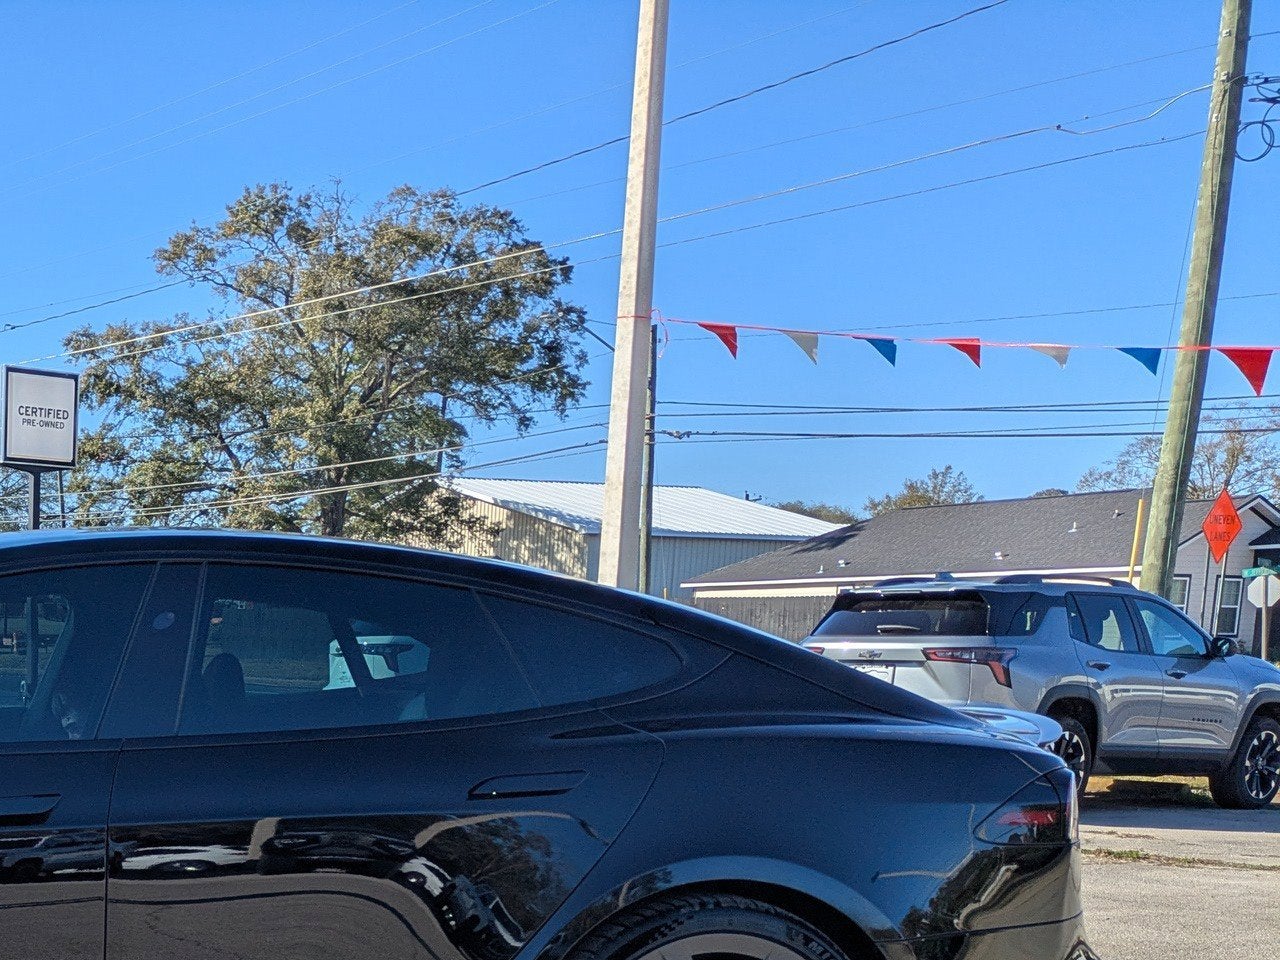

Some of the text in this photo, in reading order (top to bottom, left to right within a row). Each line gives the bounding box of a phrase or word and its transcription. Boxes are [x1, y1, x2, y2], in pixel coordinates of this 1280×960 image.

[18, 405, 70, 420] CERTIFIED
[22, 418, 65, 430] PRE-OWNED
[1209, 514, 1236, 525] UNEVEN
[1209, 531, 1231, 542] LANES
